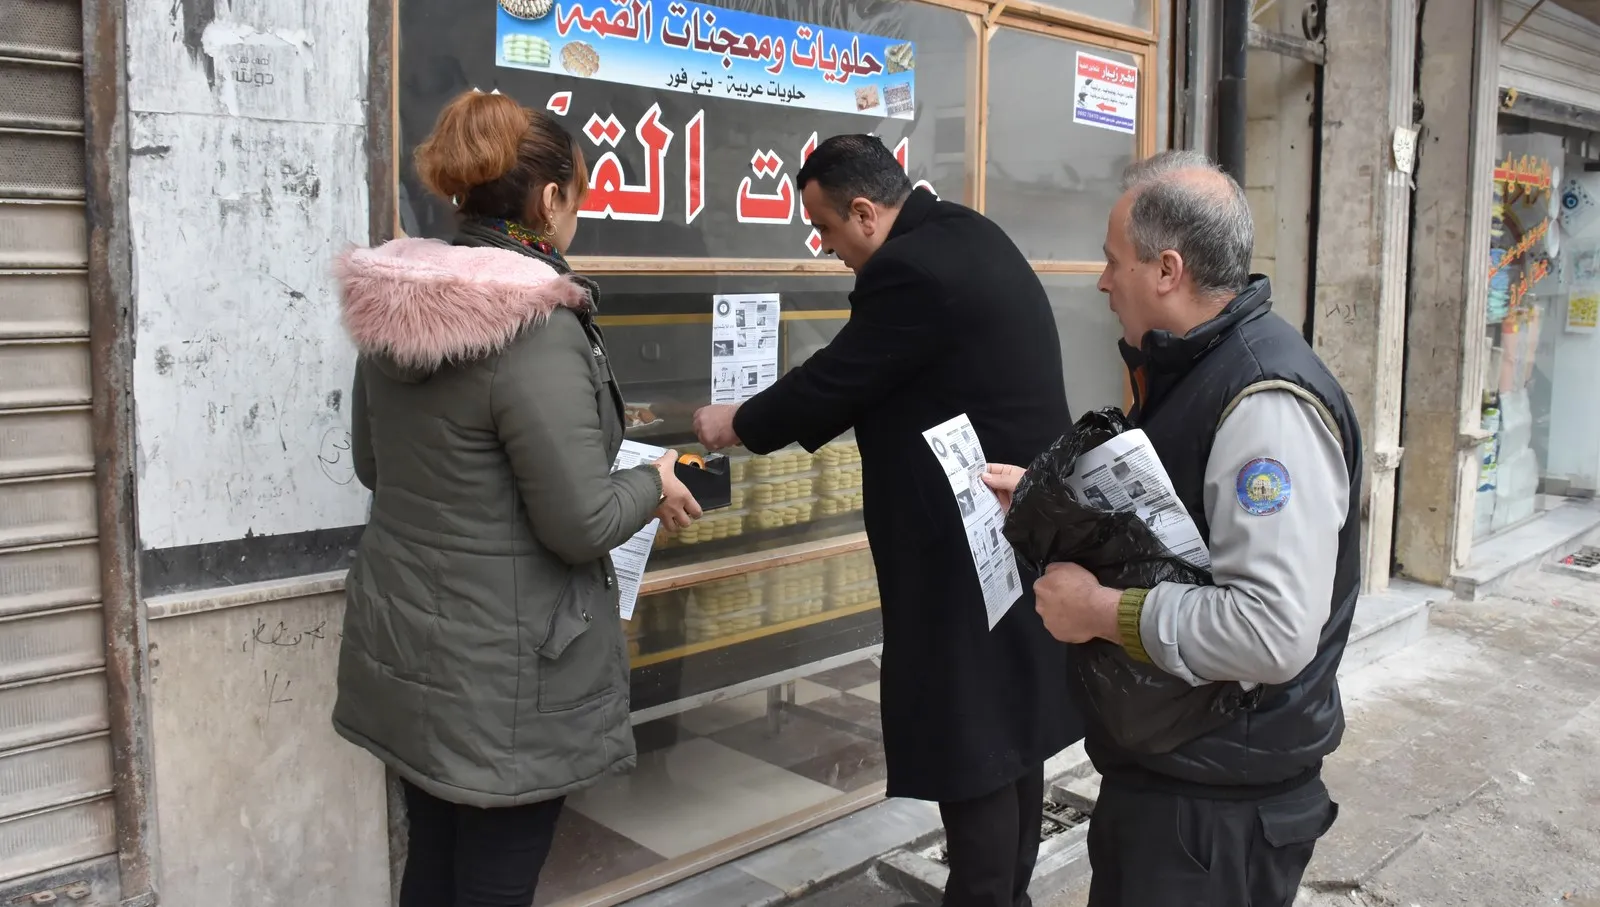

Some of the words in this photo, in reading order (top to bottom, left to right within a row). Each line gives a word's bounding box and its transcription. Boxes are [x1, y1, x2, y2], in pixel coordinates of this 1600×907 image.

[660, 1, 786, 74] ومعجنات
[791, 25, 884, 84] حلويات
[666, 68, 687, 86] فور
[691, 71, 714, 94] بتي
[726, 75, 763, 98] عربية
[767, 81, 806, 102] حلويات
[547, 91, 705, 223] الق
